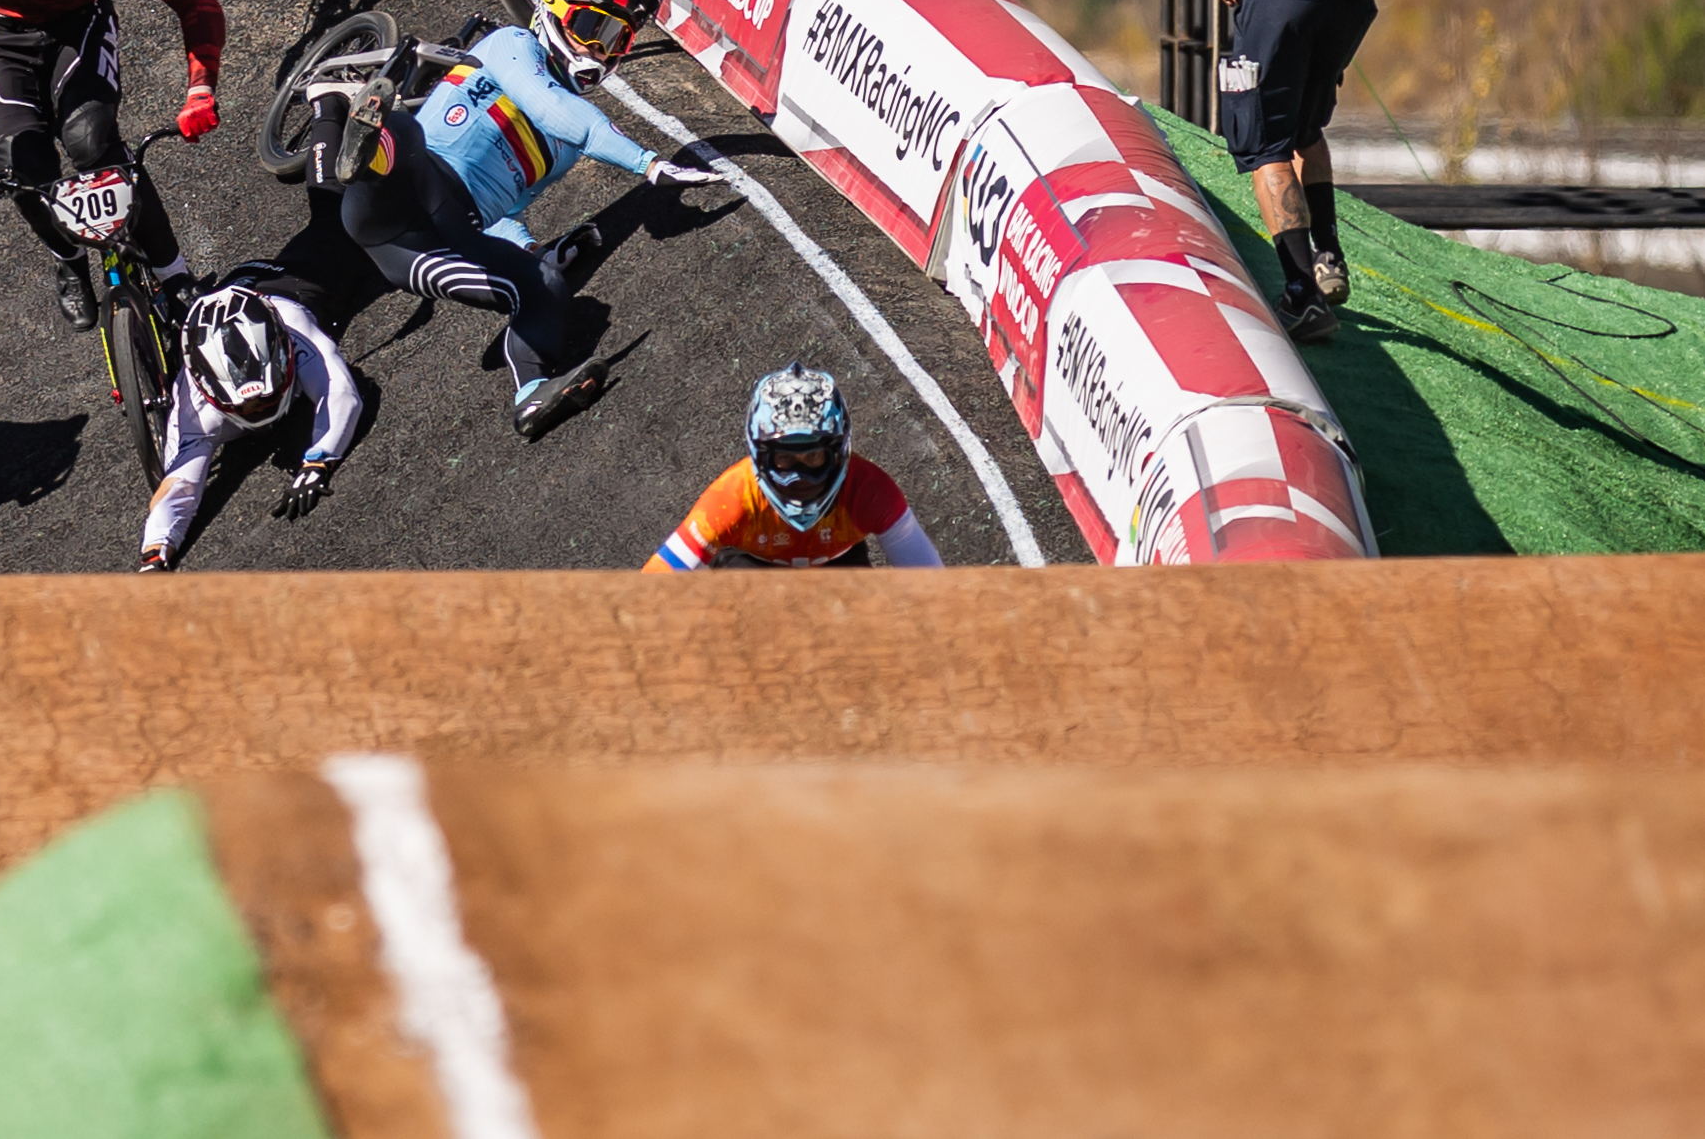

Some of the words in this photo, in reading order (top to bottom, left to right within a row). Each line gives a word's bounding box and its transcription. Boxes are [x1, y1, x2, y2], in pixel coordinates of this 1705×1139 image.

[447, 107, 465, 124] Esso
[71, 188, 119, 225] 209
[1023, 228, 1063, 300] RACING
[240, 384, 262, 397] BELL
[1056, 310, 1153, 488] #BMXRacingWC
